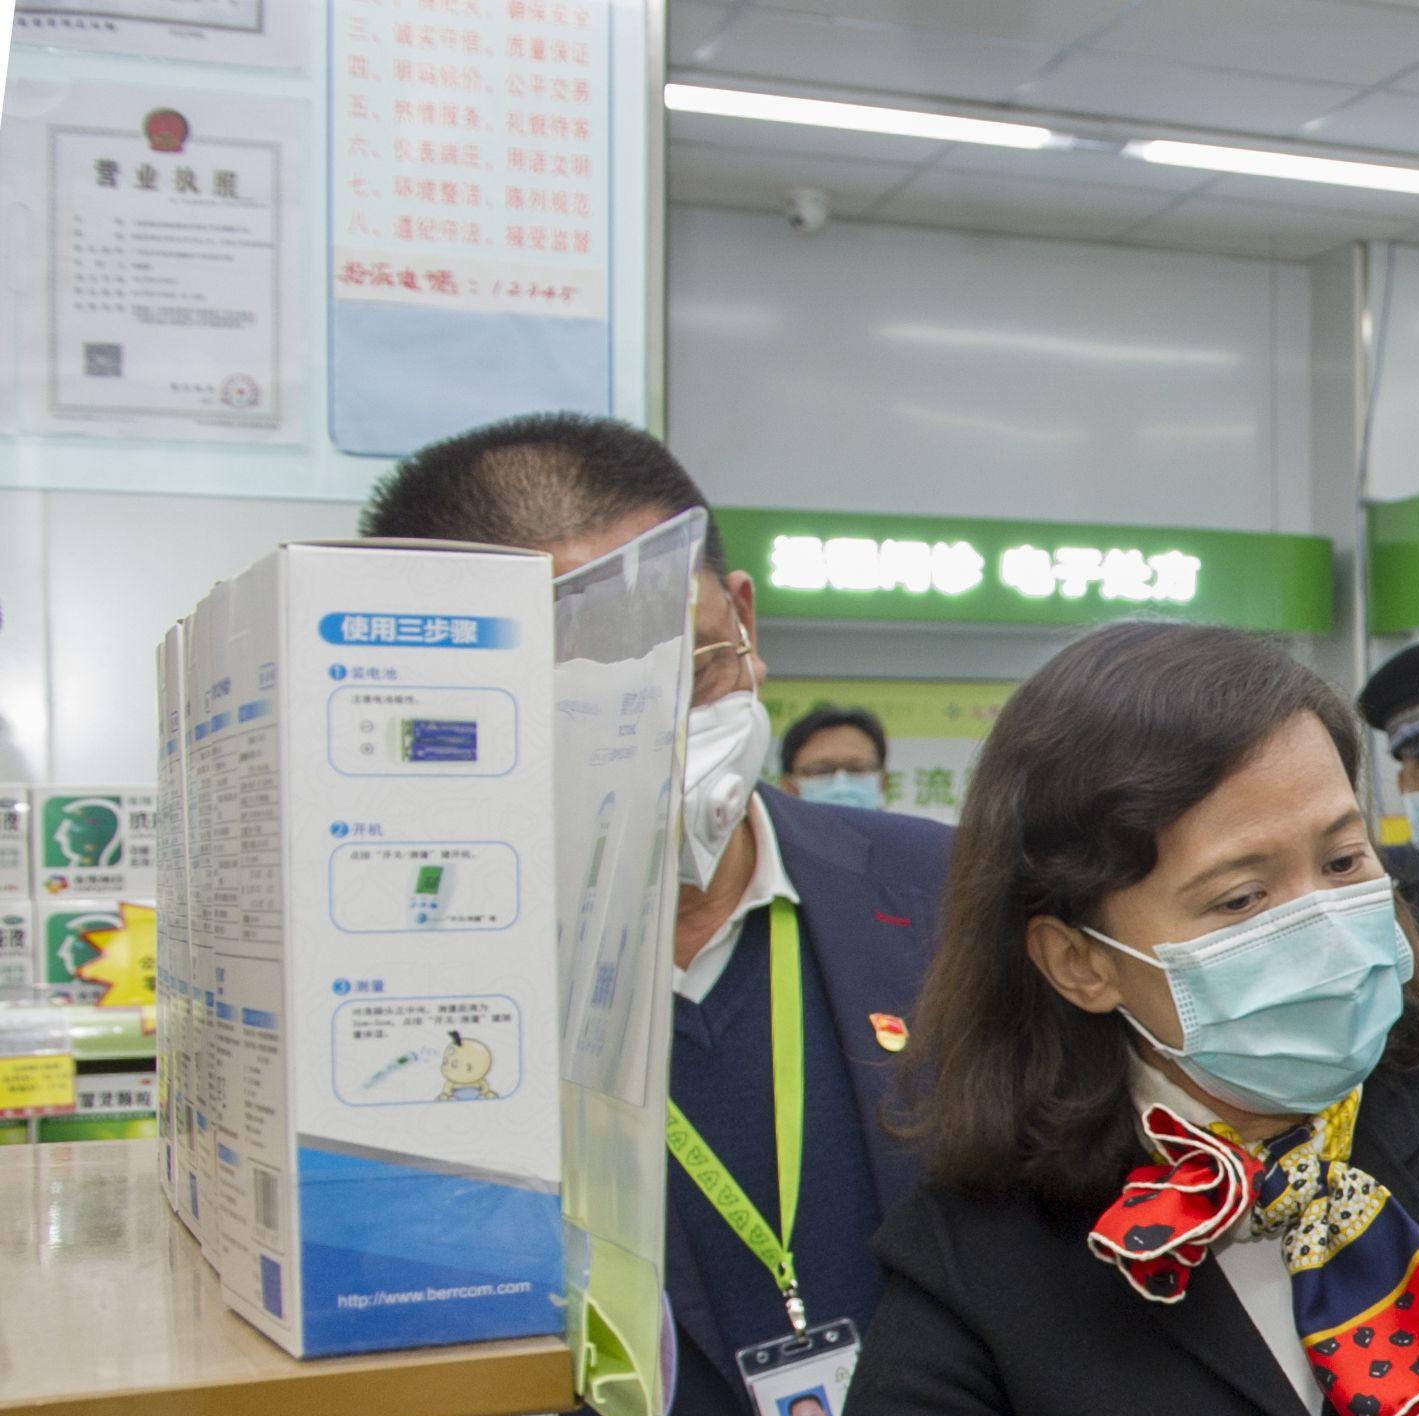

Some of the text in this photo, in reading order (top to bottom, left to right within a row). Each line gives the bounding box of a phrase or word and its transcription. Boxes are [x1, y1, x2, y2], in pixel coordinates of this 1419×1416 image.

[94, 157, 240, 199] 营业执照
[340, 615, 480, 646] 使用三步骤
[351, 666, 399, 681] 装电池
[352, 822, 384, 837] 开机
[355, 979, 385, 994] 测量
[336, 1280, 533, 1310] http://www.berrcom.com
